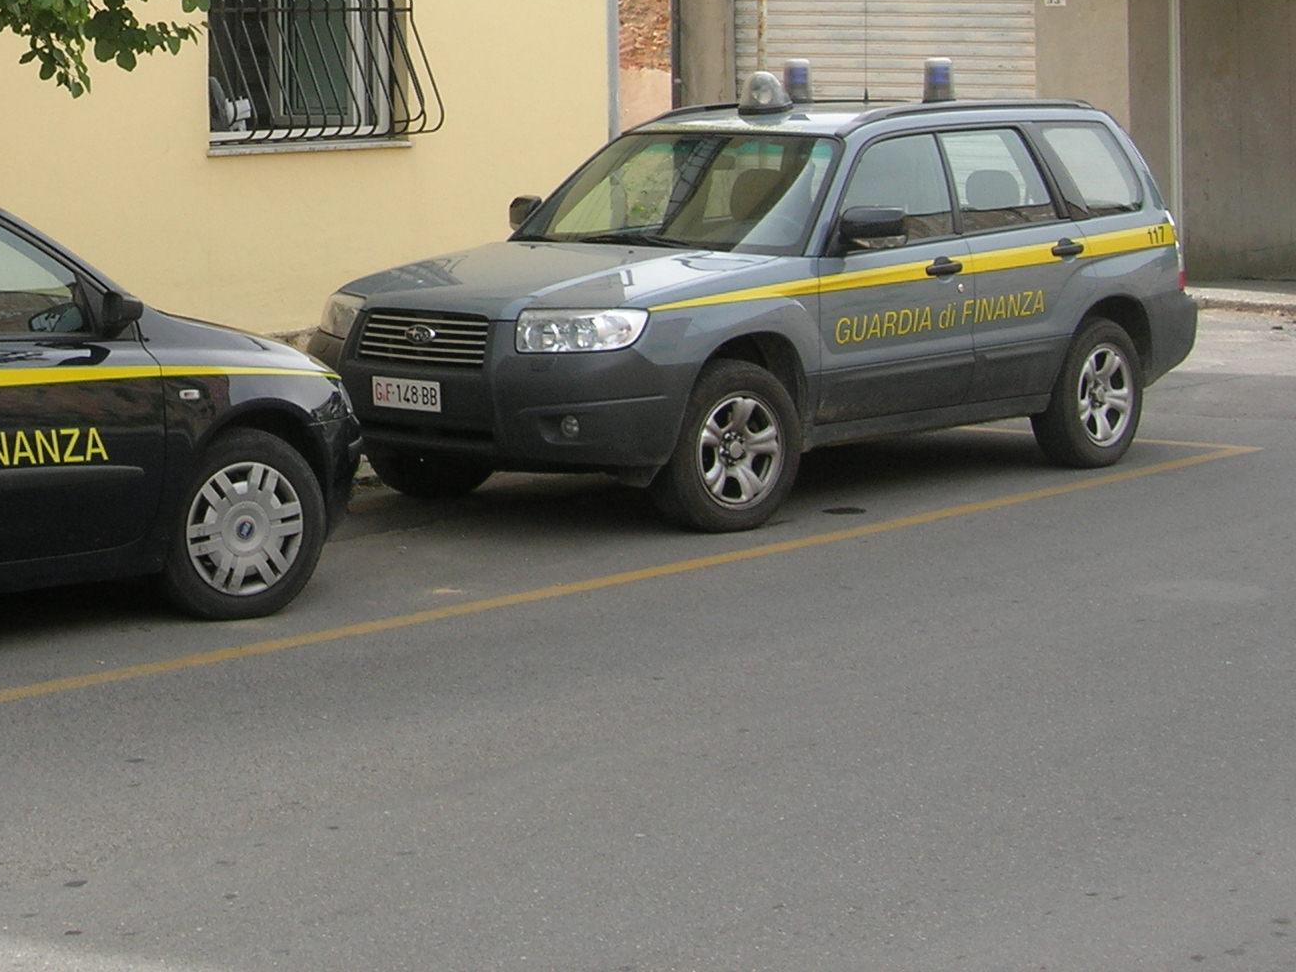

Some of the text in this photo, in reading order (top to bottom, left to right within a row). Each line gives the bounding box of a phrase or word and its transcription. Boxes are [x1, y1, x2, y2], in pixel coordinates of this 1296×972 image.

[1147, 225, 1165, 245] 117
[835, 289, 1045, 345] GUARDIA di FINANZA
